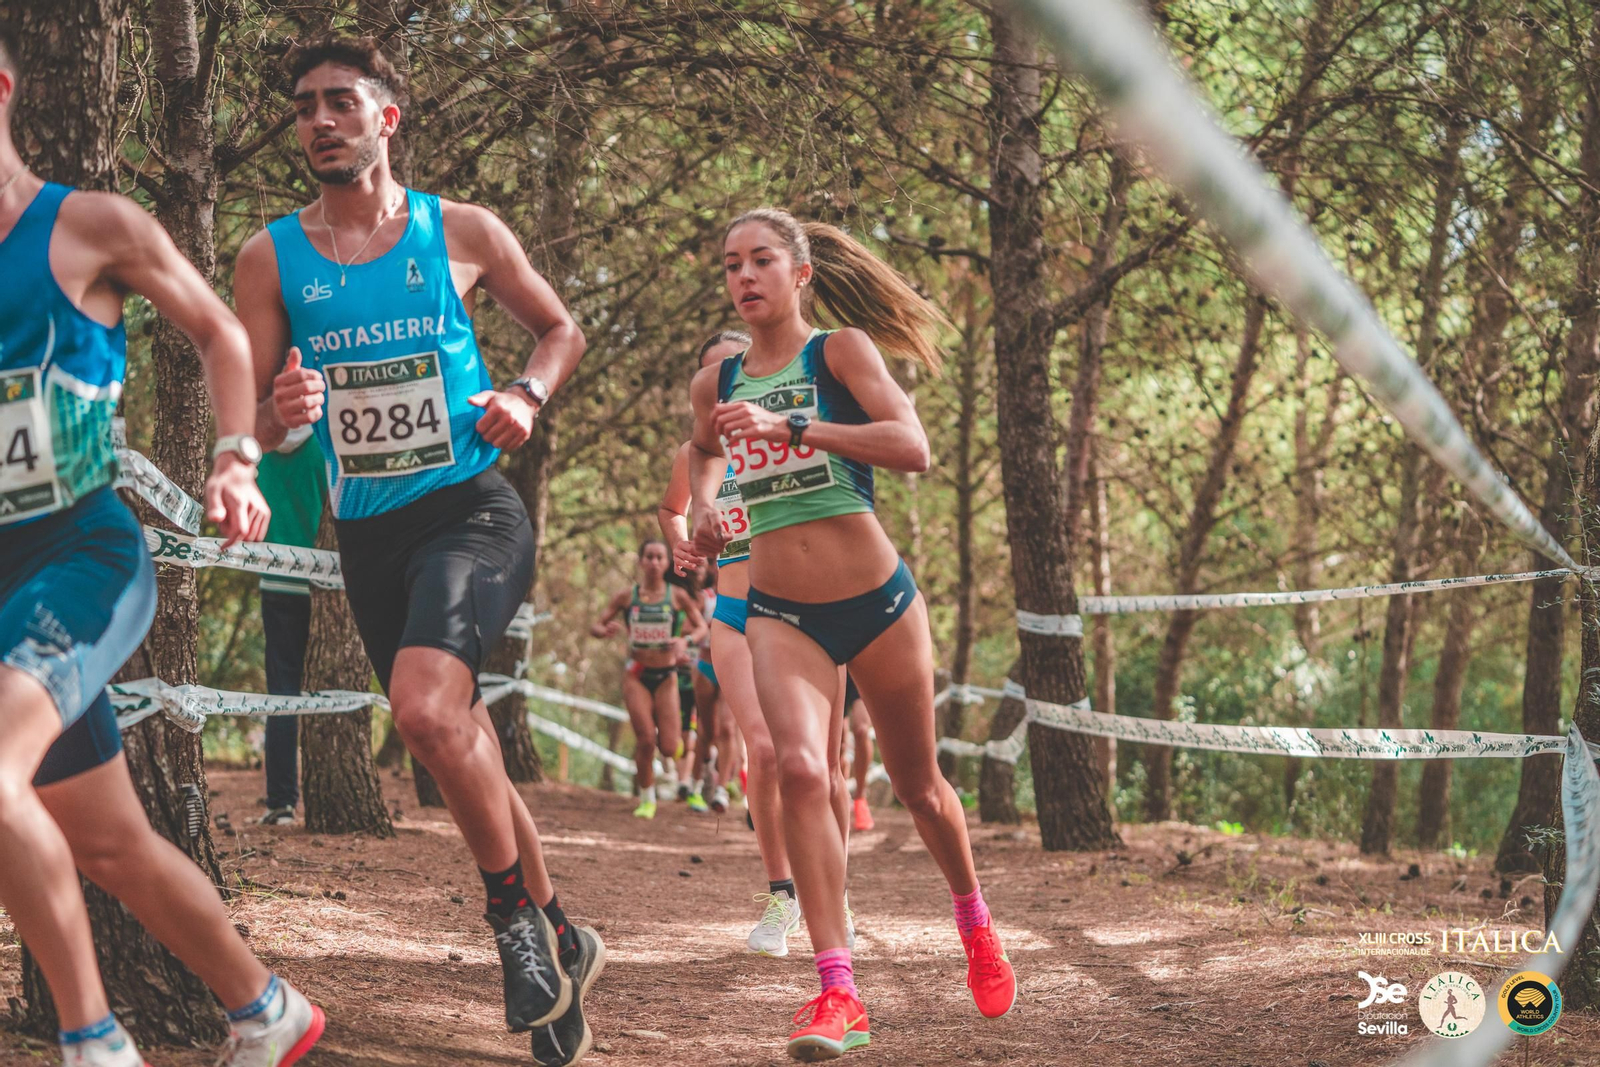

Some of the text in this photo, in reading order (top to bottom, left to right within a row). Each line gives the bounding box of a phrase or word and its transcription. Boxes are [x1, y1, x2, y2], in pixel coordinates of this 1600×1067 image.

[352, 363, 410, 383] ITÁLICA
[339, 398, 441, 444] 8284
[0, 428, 38, 471] 4
[722, 480, 740, 492] ITÁ
